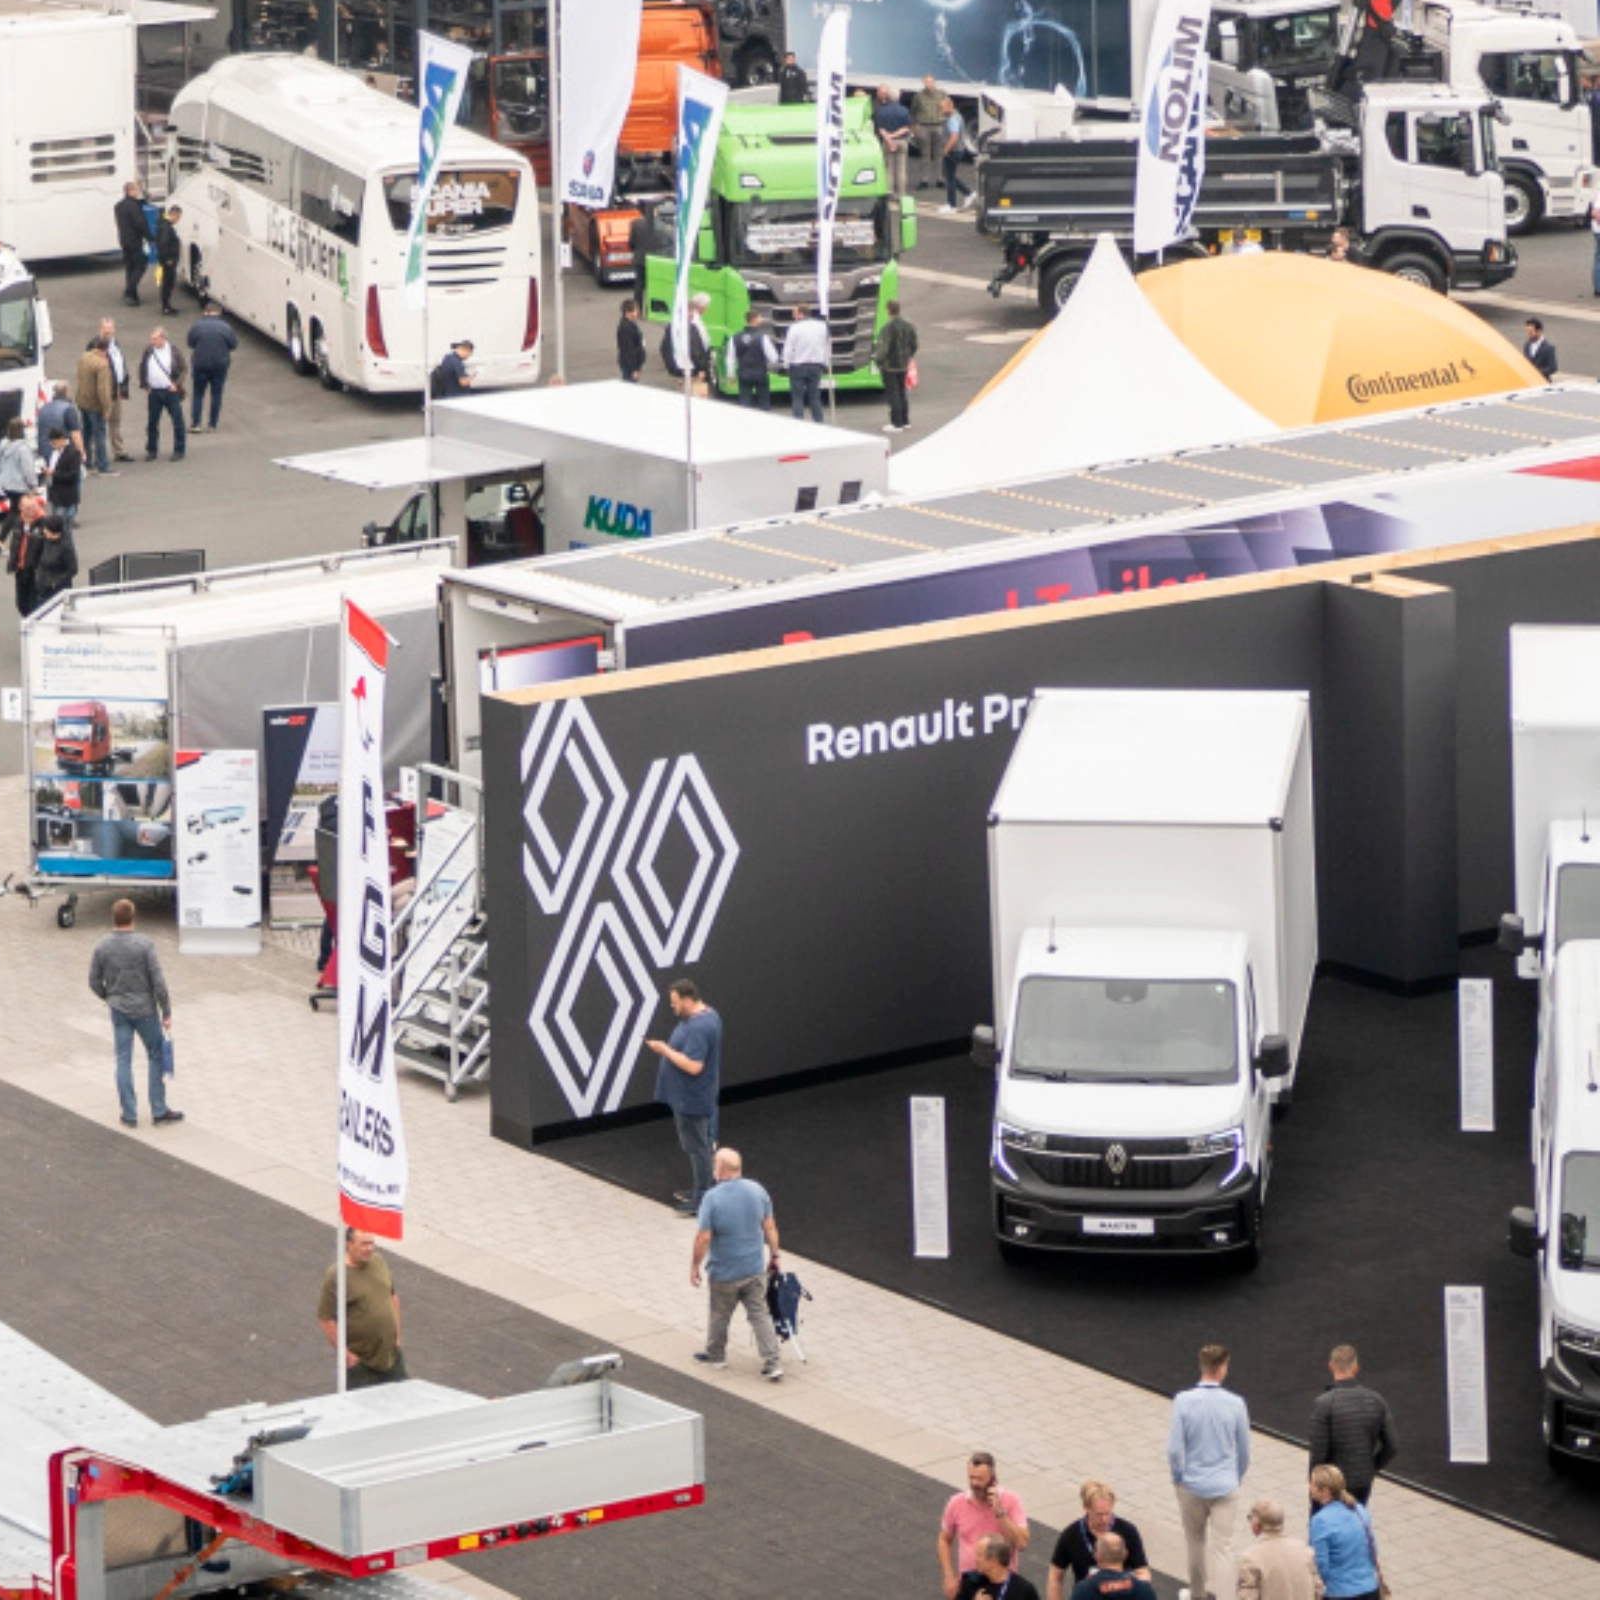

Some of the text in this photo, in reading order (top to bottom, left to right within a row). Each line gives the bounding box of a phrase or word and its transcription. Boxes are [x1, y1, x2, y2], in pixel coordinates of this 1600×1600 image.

[1346, 361, 1460, 403] Continental
[582, 494, 653, 539] KUDA
[807, 693, 1036, 765] Renault Pr
